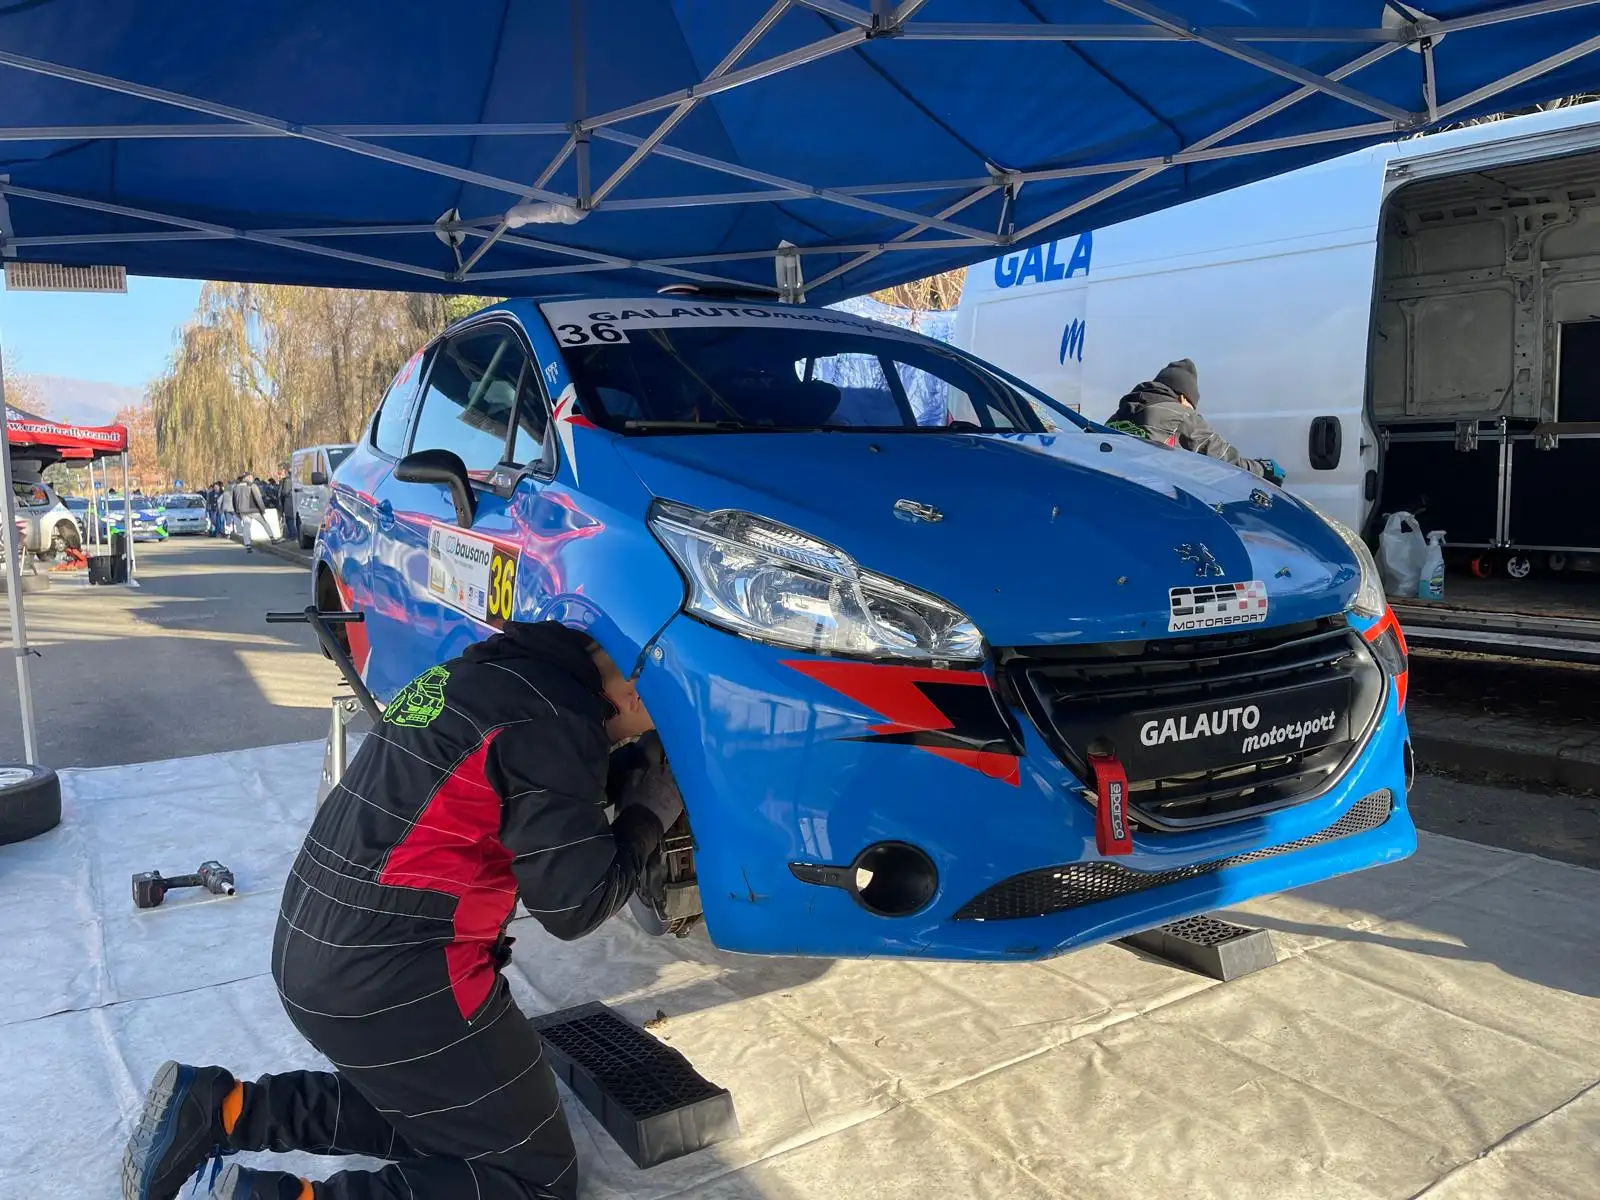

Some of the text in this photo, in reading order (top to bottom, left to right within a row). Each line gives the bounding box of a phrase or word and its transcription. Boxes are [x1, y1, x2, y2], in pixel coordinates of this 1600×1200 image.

[995, 231, 1092, 288] GALA
[558, 322, 623, 345] 36
[455, 539, 490, 566] bausano
[488, 555, 515, 620] 36
[1173, 613, 1265, 631] MOTORSPORT
[1140, 705, 1260, 746] GALAUTO
[1242, 711, 1336, 753] motorsport
[1111, 783, 1125, 839] sparco
